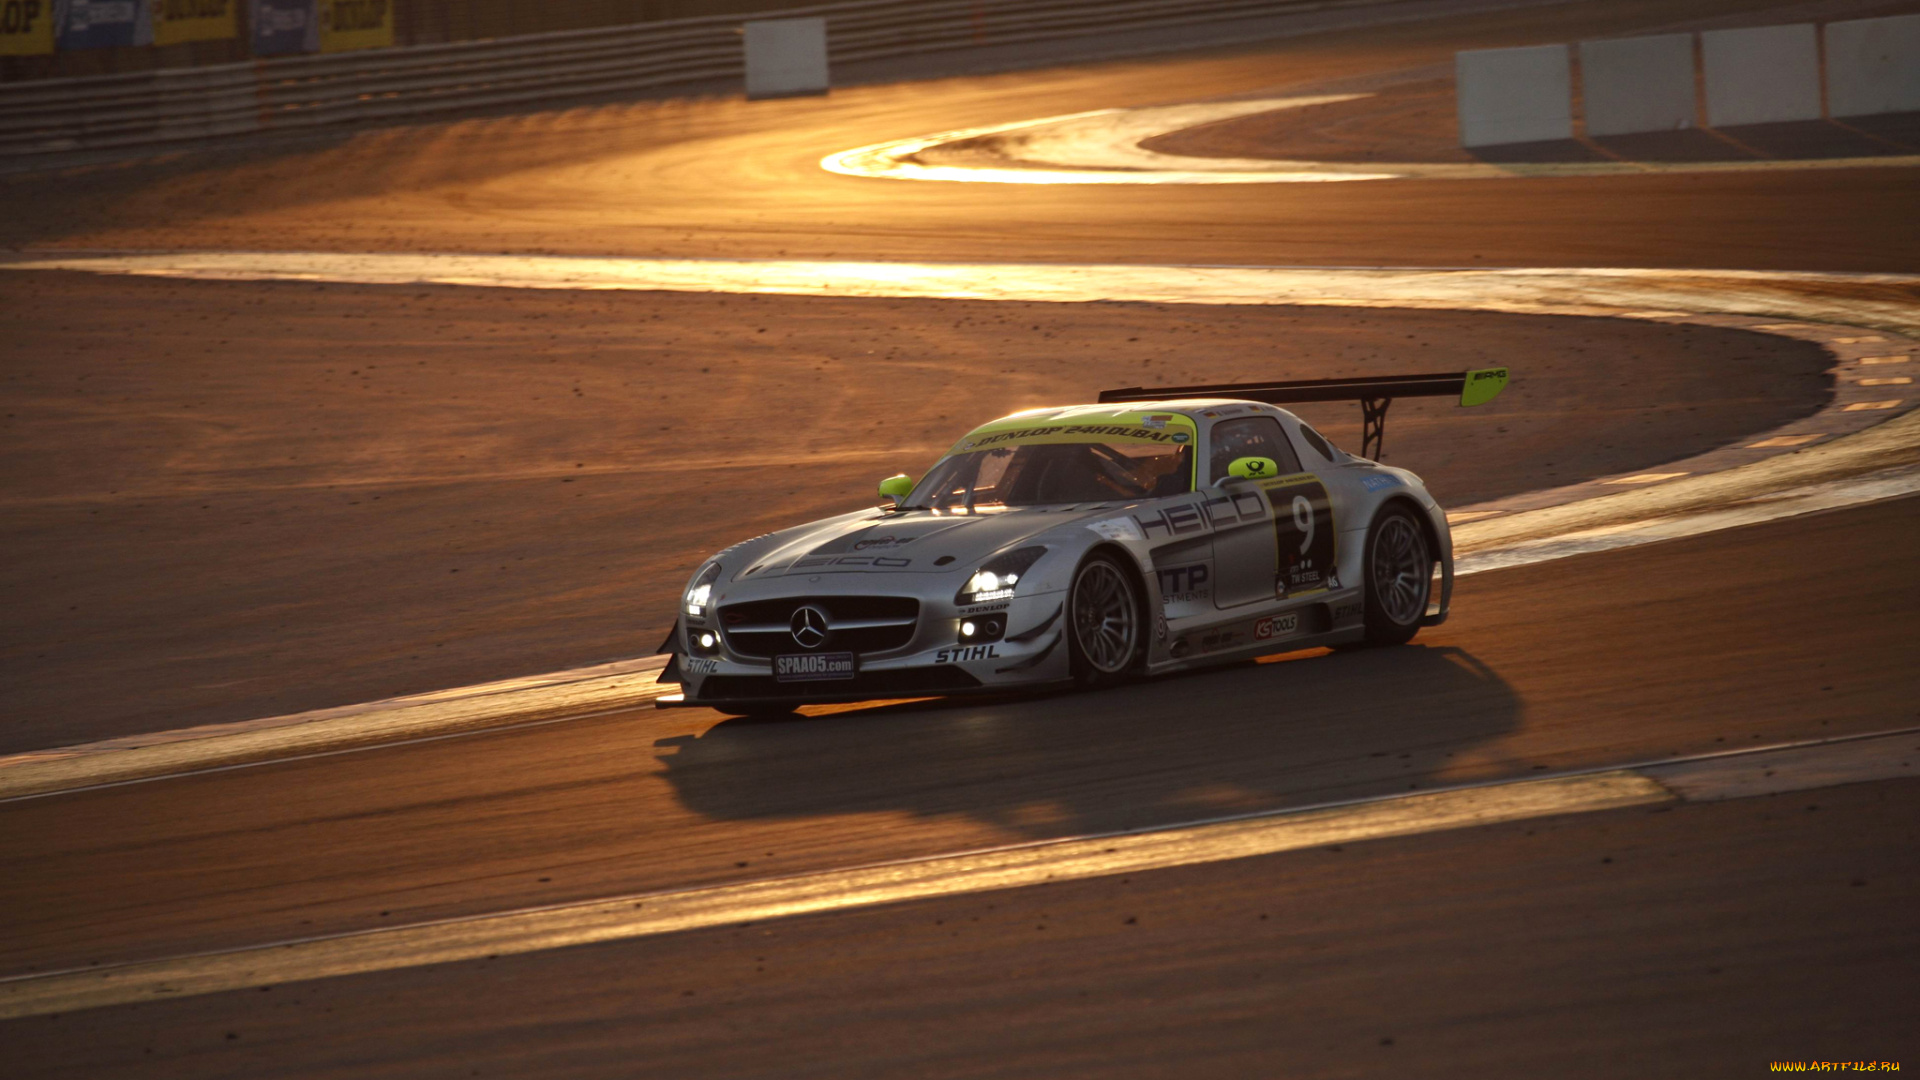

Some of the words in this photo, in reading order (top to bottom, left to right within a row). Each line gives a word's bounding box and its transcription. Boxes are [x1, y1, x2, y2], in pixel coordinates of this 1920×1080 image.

[974, 426, 1064, 447] DUNLOP
[1103, 426, 1173, 443] DUBAI
[1133, 490, 1266, 540] HEICO
[1292, 495, 1315, 555] 9
[1301, 570, 1321, 583] STEEL
[967, 603, 1010, 614] DUNLOP
[1271, 616, 1296, 632] TOOLS
[935, 645, 1000, 664] STIHL
[687, 659, 718, 673] STIHL
